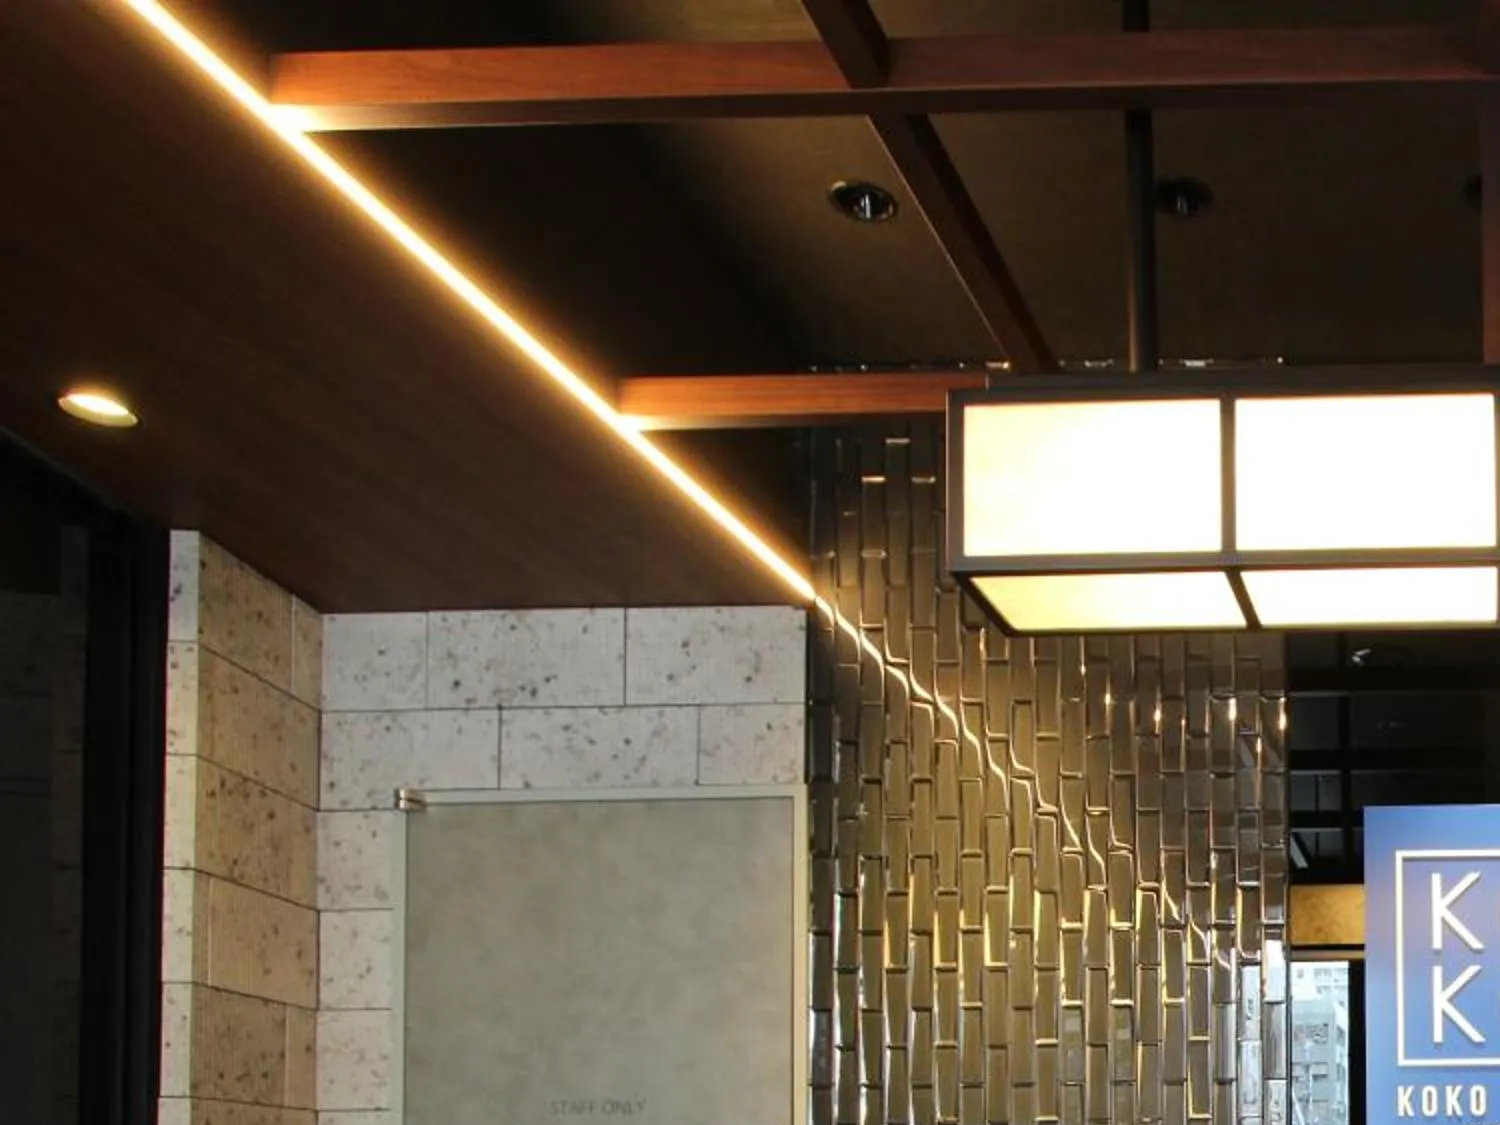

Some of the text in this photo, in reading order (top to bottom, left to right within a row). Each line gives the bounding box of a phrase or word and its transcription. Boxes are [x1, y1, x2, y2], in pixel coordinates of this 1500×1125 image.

[549, 1097, 648, 1117] STAFF ONLY
[1397, 1085, 1487, 1117] KOKO
